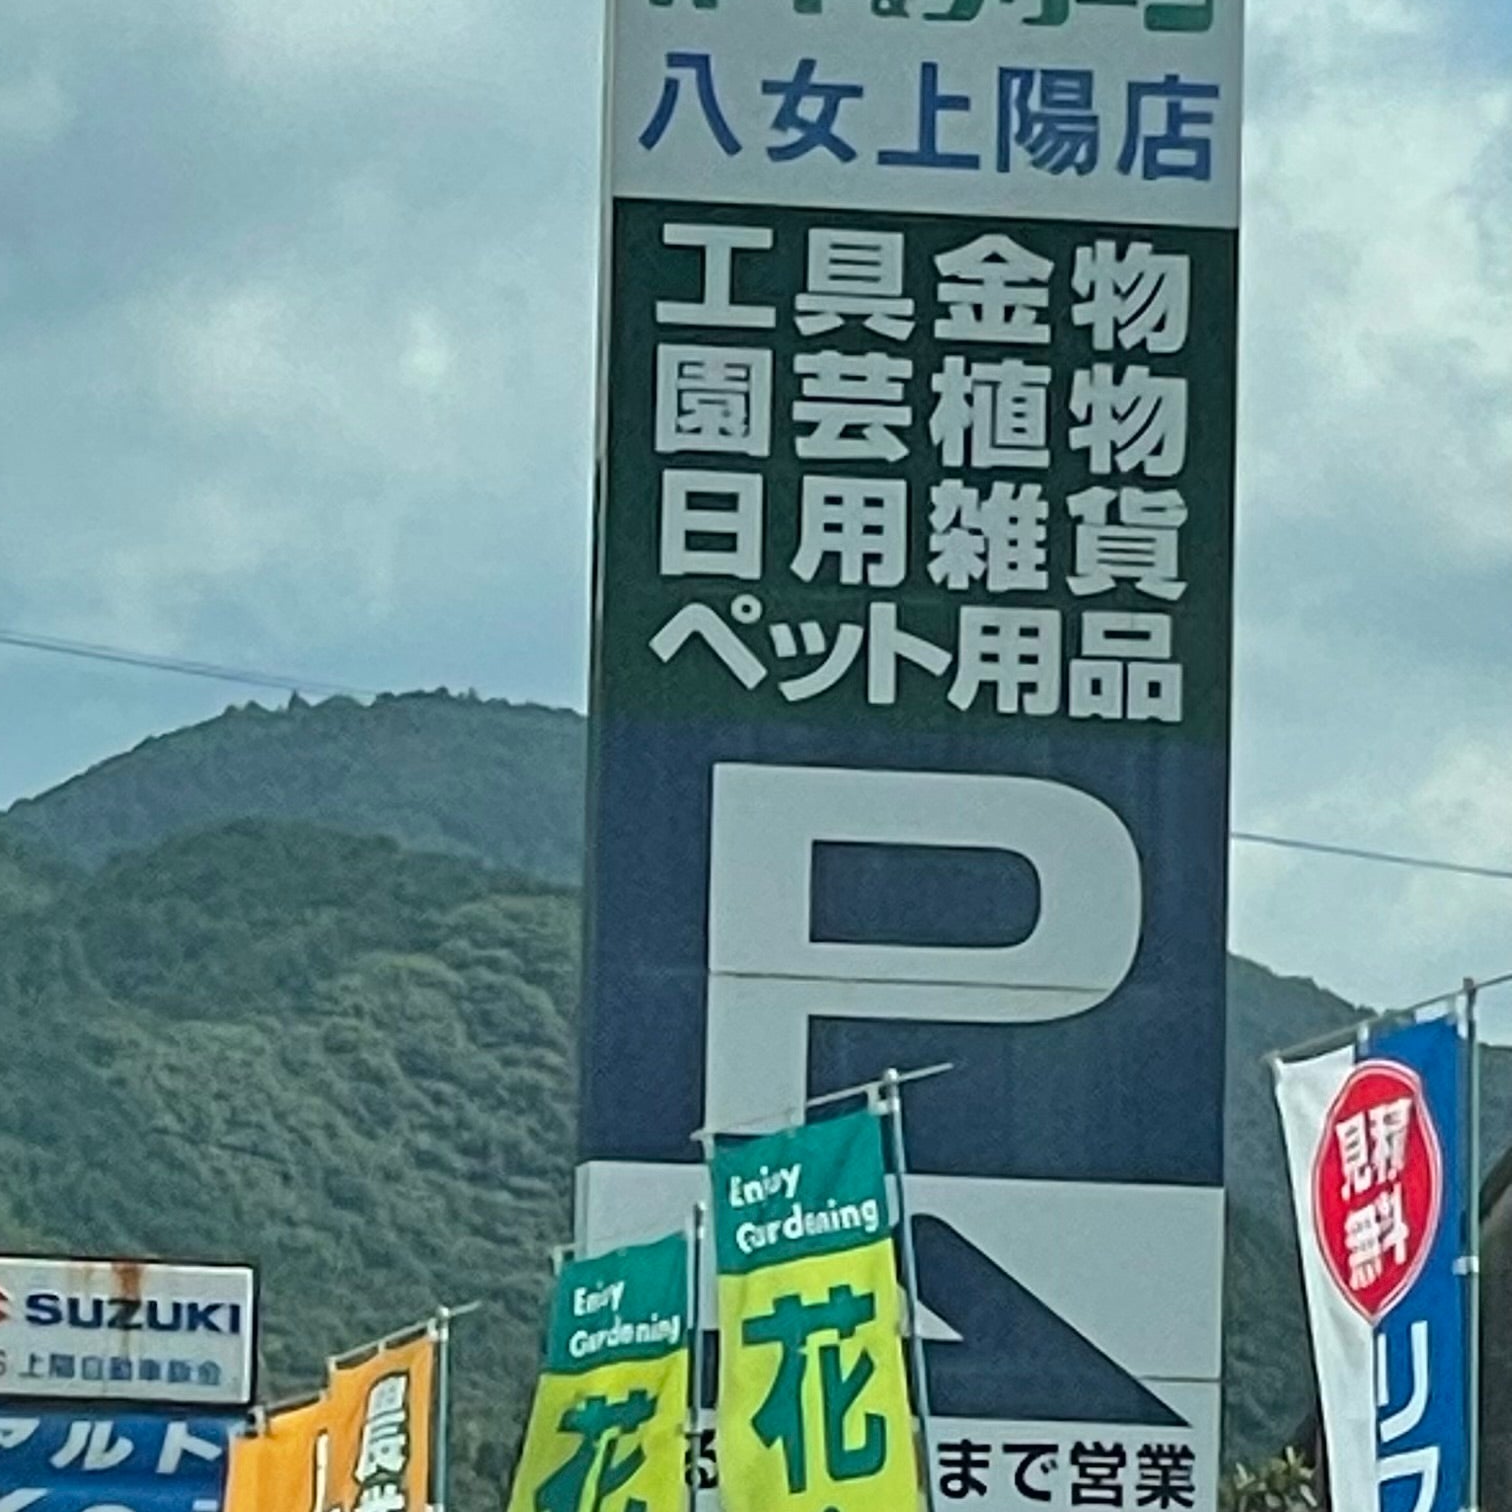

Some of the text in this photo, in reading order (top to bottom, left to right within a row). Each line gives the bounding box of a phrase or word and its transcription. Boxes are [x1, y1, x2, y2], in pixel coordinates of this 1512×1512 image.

[638, 52, 1220, 181] 八女上陽店
[655, 223, 1190, 353] 工具金物
[655, 343, 1188, 476] 園芸植物
[659, 468, 1187, 601] 日用雑貨
[648, 593, 1183, 722] ペット用品
[703, 762, 1142, 1134] P
[729, 1163, 801, 1208] Enjoy
[25, 1293, 241, 1335] SUZUKI
[741, 1284, 888, 1495] 花
[937, 1438, 1197, 1510] まで営業
